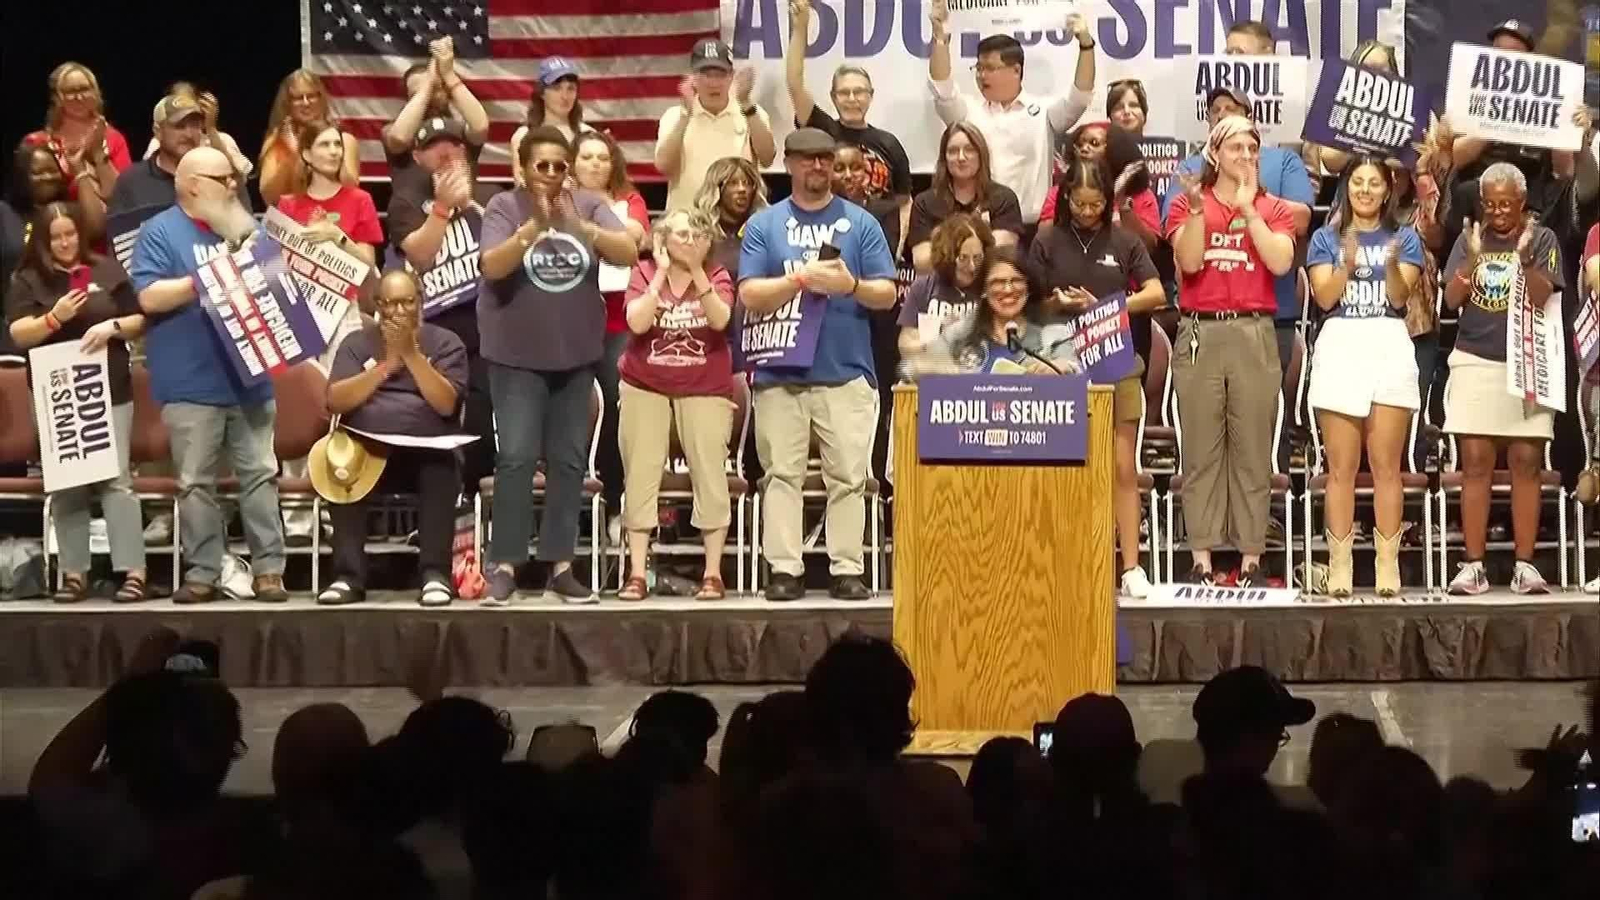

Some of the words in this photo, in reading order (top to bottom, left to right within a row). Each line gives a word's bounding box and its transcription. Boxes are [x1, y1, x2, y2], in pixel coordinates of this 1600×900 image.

[1195, 61, 1284, 97] ABDUL
[1334, 65, 1416, 123] ABDUL
[1470, 53, 1564, 100] ABDUL
[1345, 109, 1414, 148] SENATE
[1488, 94, 1562, 129] SENATE
[786, 224, 835, 250] UAW
[1210, 232, 1245, 248] DFT
[316, 248, 358, 280] POLITICS
[423, 251, 482, 298] SENATE
[316, 290, 338, 316] ALL
[751, 321, 801, 352] SENATE
[1080, 343, 1102, 370] FOR
[1104, 332, 1125, 357] ALL
[1534, 332, 1549, 398] MEDICARE
[51, 388, 80, 464] SENATE
[71, 363, 111, 460] ABDUL
[929, 400, 990, 425] ABDUL
[1009, 400, 1076, 425] SENATE
[964, 431, 985, 445] TEXT
[987, 430, 1006, 445] WIN
[1010, 431, 1020, 445] TO
[1021, 431, 1047, 445] 74801
